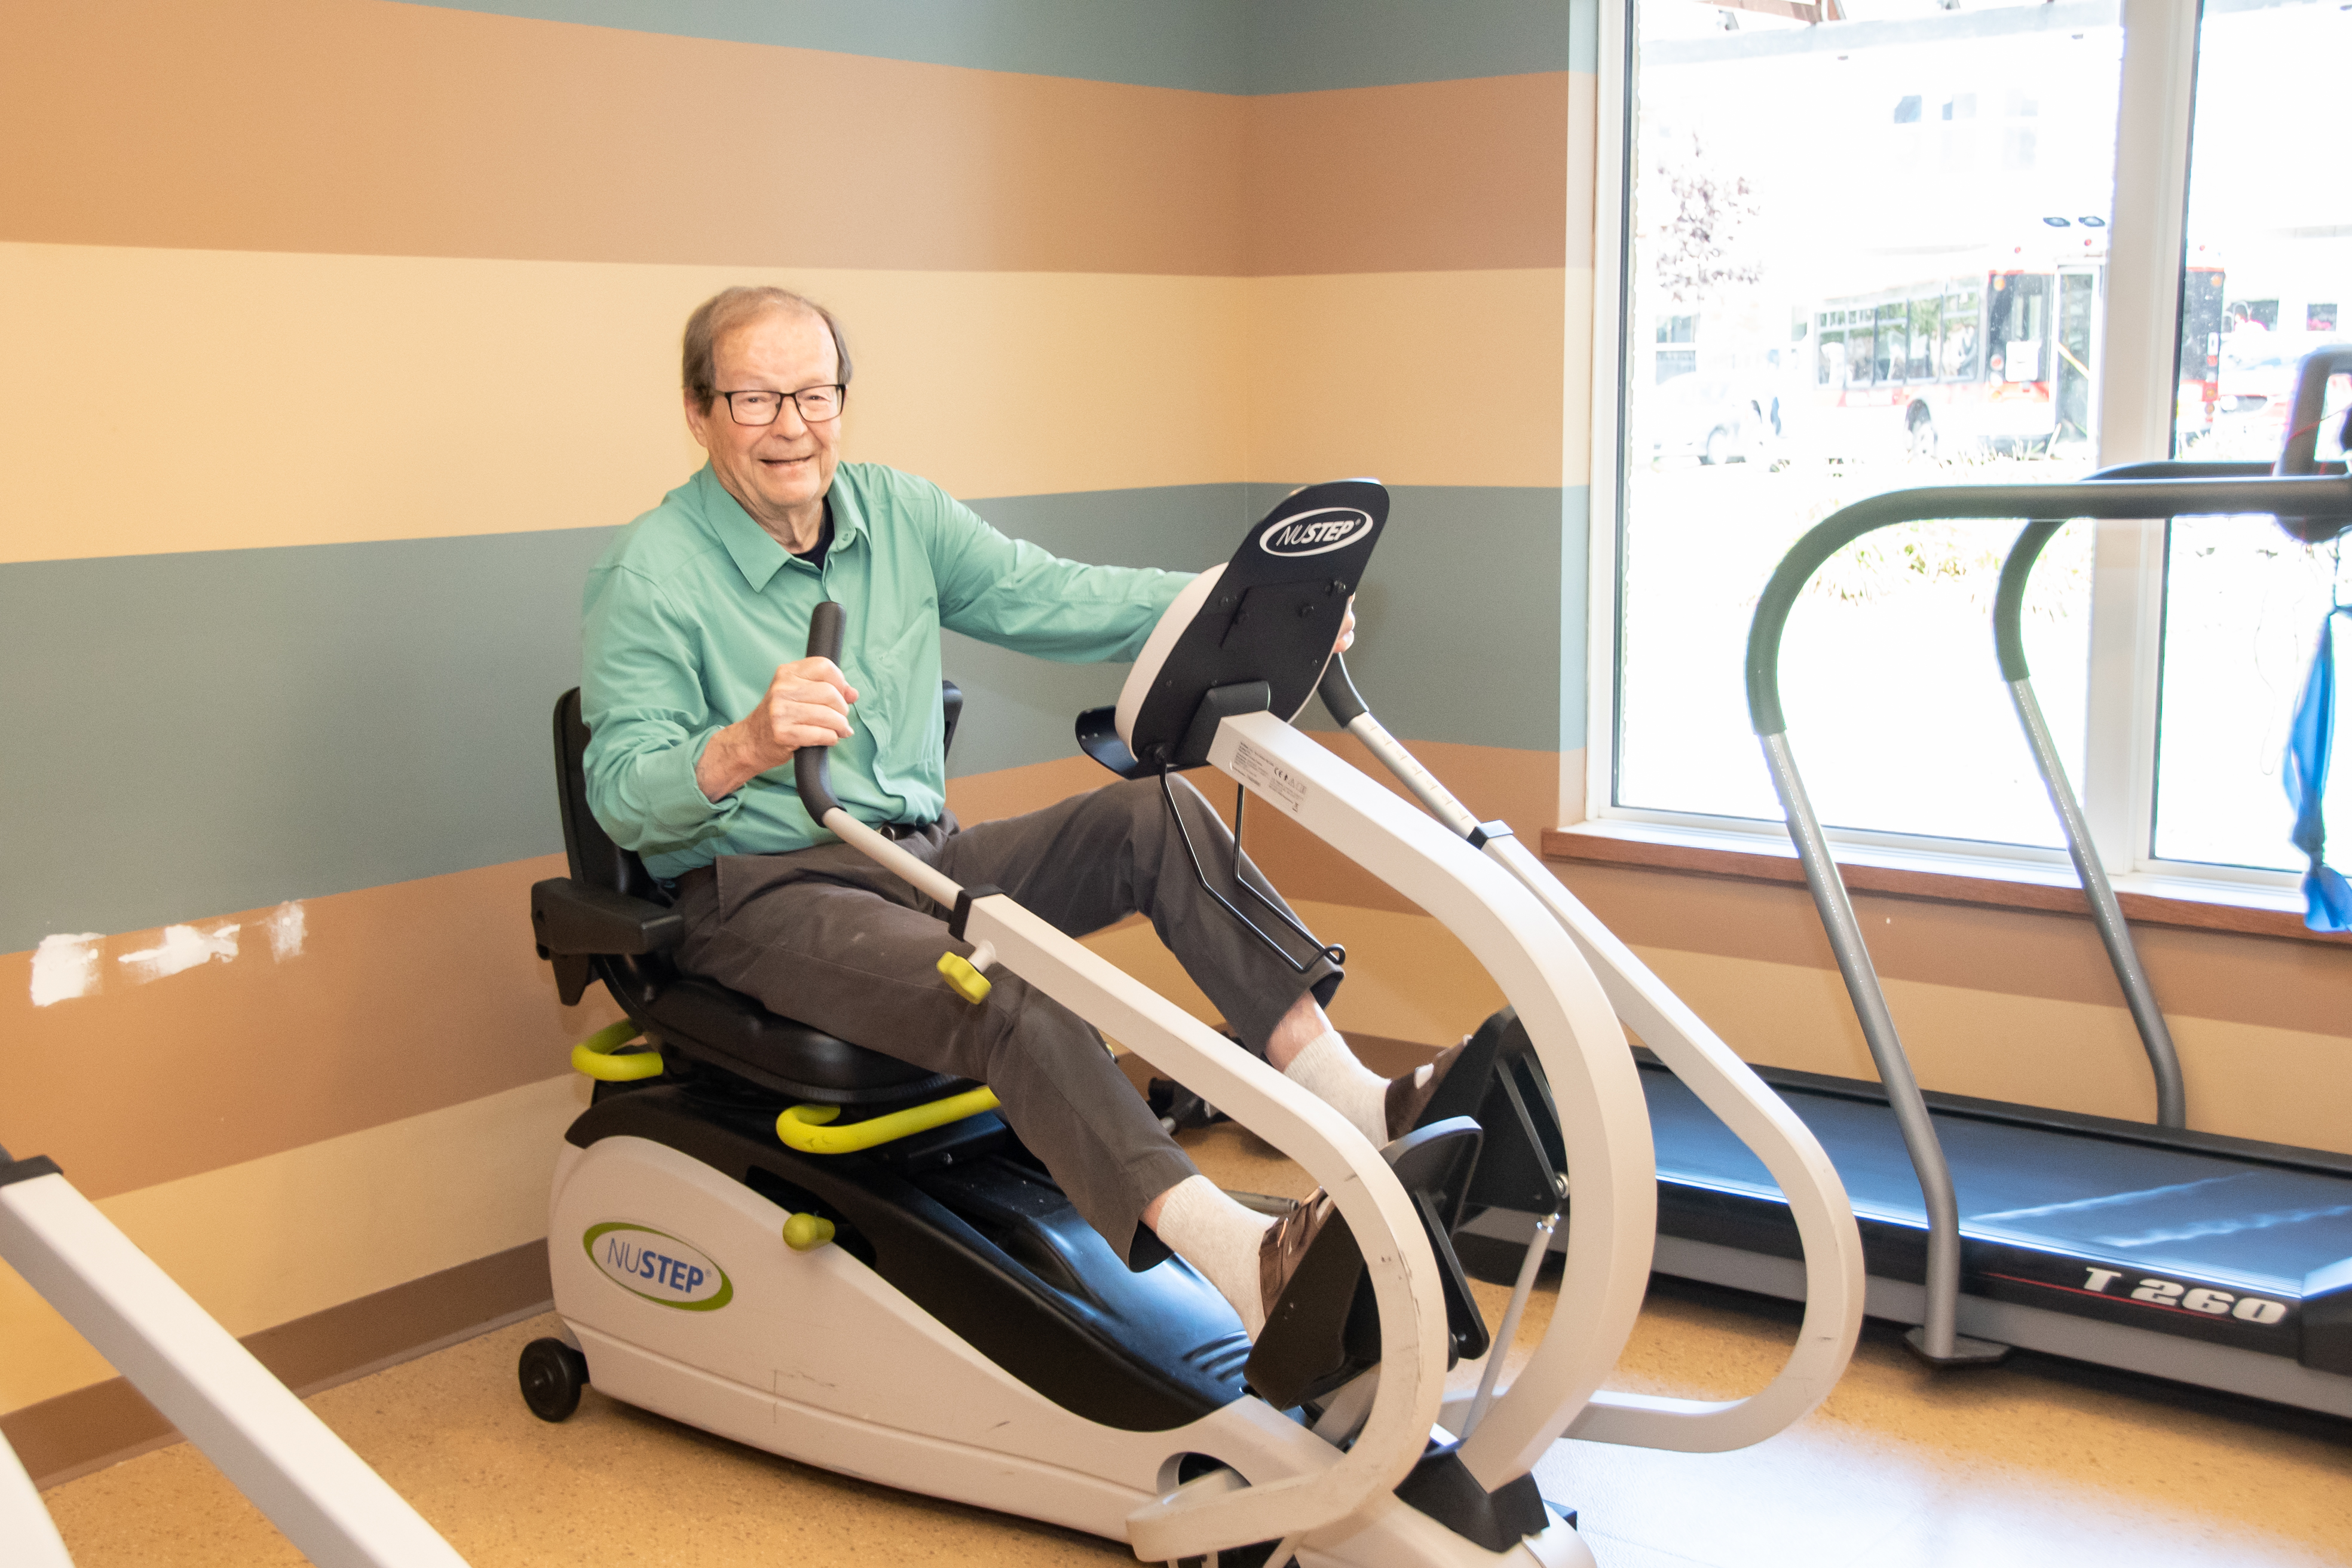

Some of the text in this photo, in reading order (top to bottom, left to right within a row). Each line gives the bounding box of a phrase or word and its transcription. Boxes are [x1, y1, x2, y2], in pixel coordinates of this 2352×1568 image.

[1276, 520, 1355, 546] NUSTEP
[607, 1237, 705, 1294] NUSTEP
[2084, 1266, 2287, 1325] T 260
